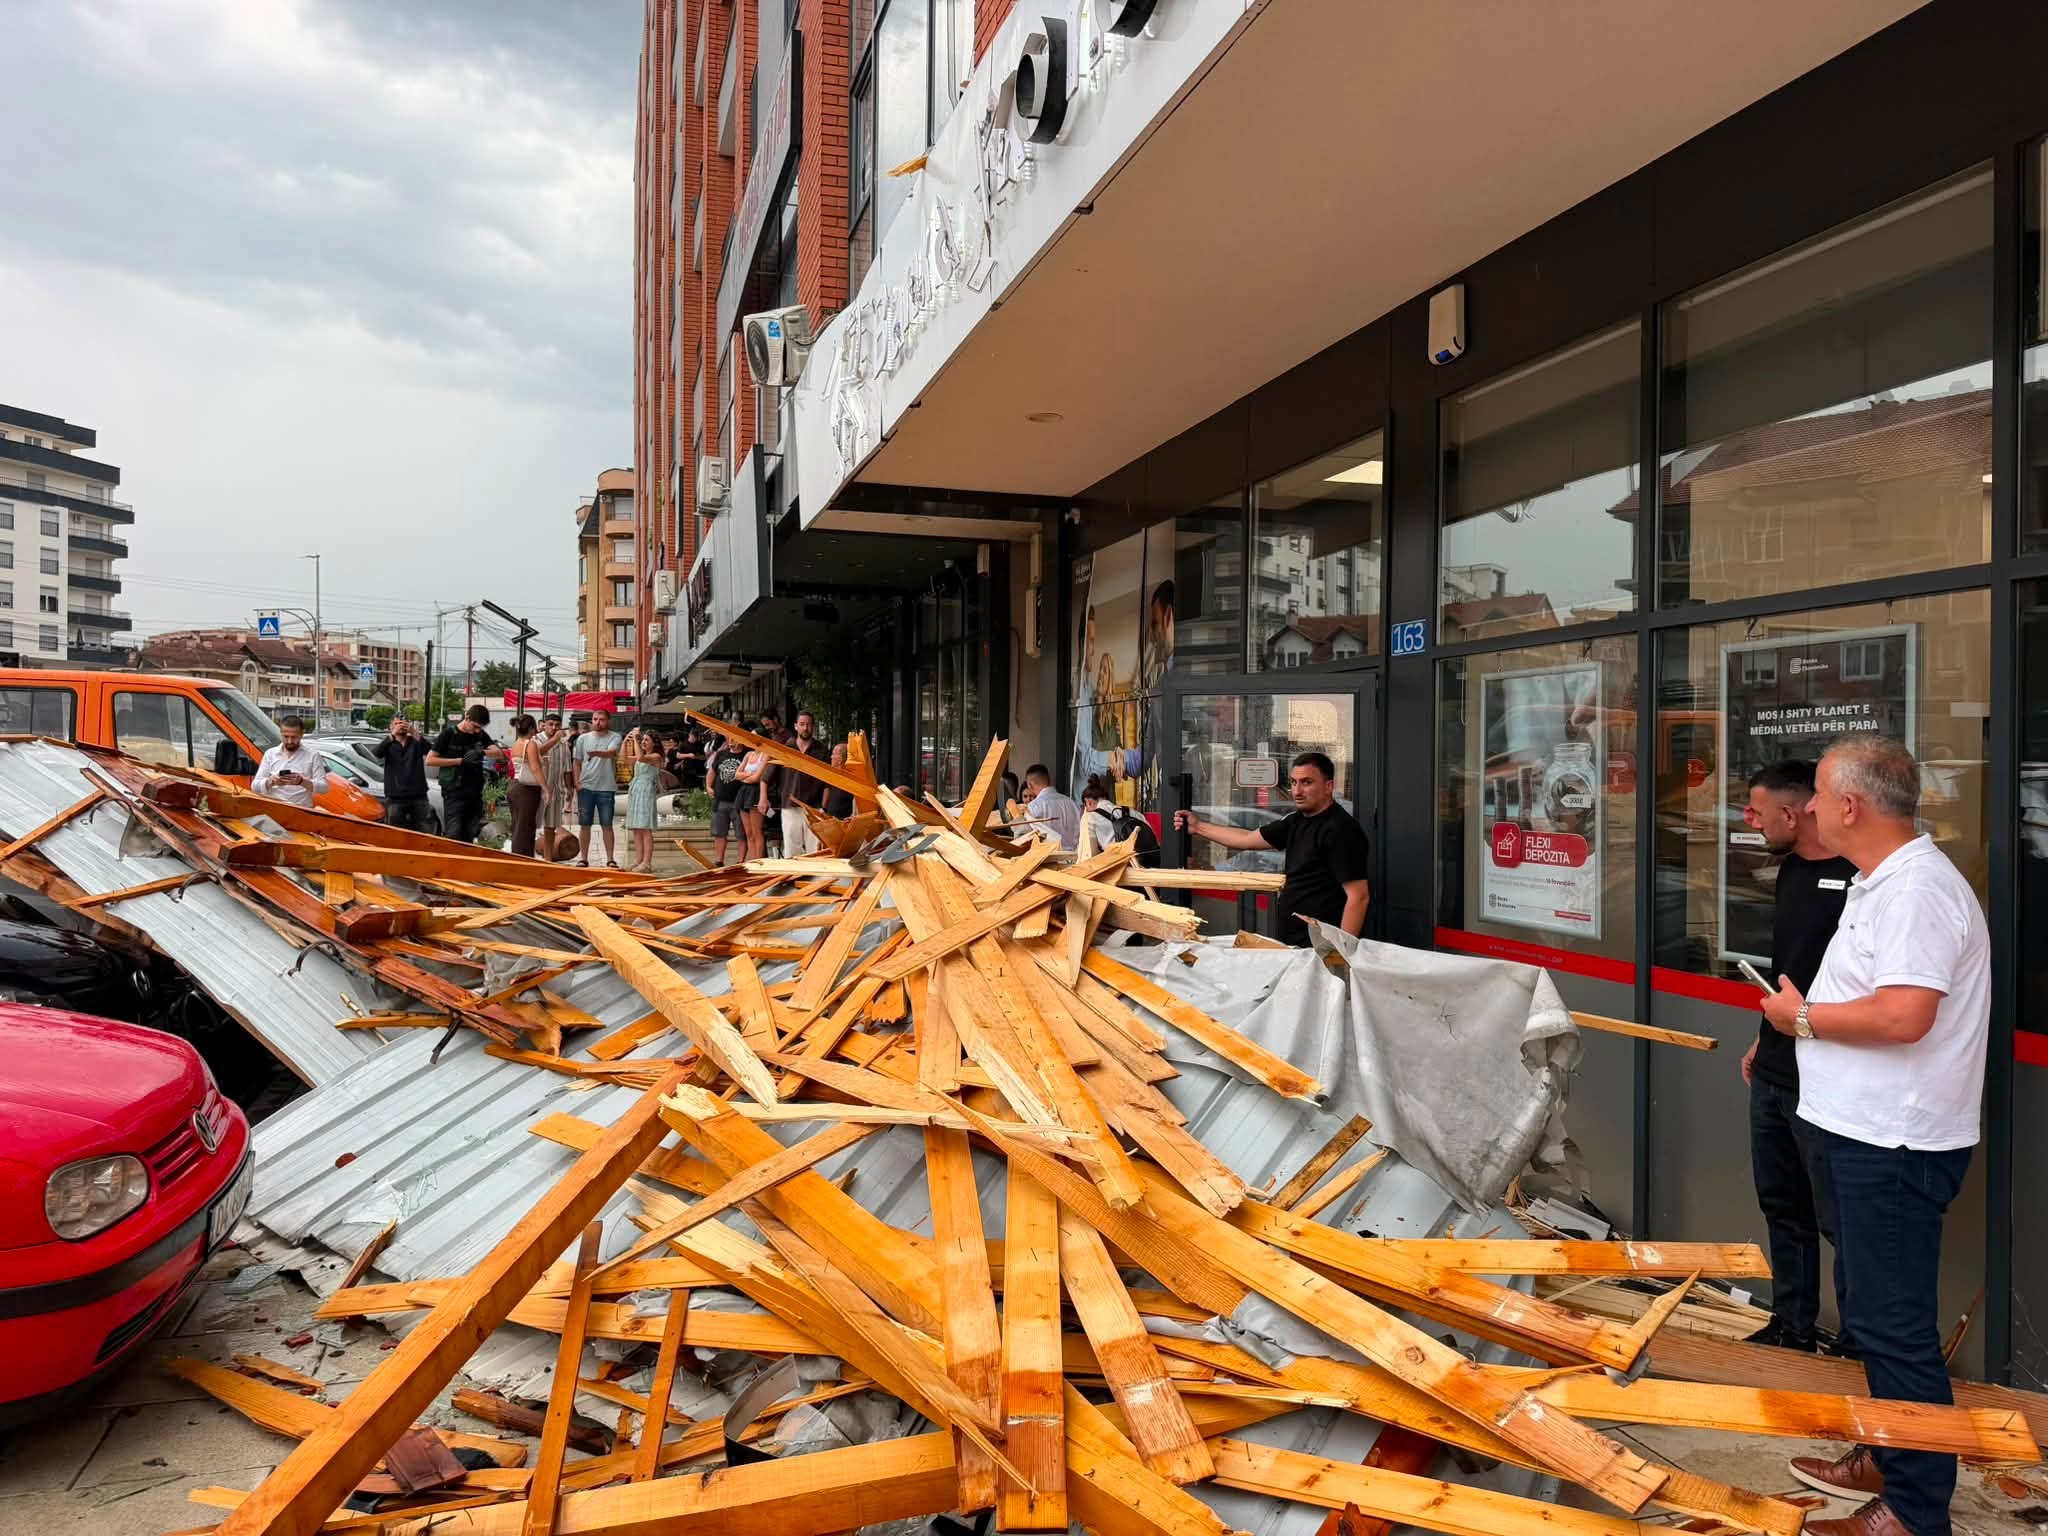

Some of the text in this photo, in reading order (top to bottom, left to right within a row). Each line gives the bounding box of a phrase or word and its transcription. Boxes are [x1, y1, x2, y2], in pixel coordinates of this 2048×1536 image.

[1394, 623, 1424, 653] 163
[1757, 710, 1778, 720] MOS
[1786, 708, 1812, 718] SHTY
[1815, 705, 1860, 716] PLANET
[1863, 704, 1870, 713] E
[1750, 720, 1878, 735] MËDHA VETËM PËR PARA
[1526, 836, 1551, 848] FLEXI
[1525, 849, 1571, 864] DEPOZITA
